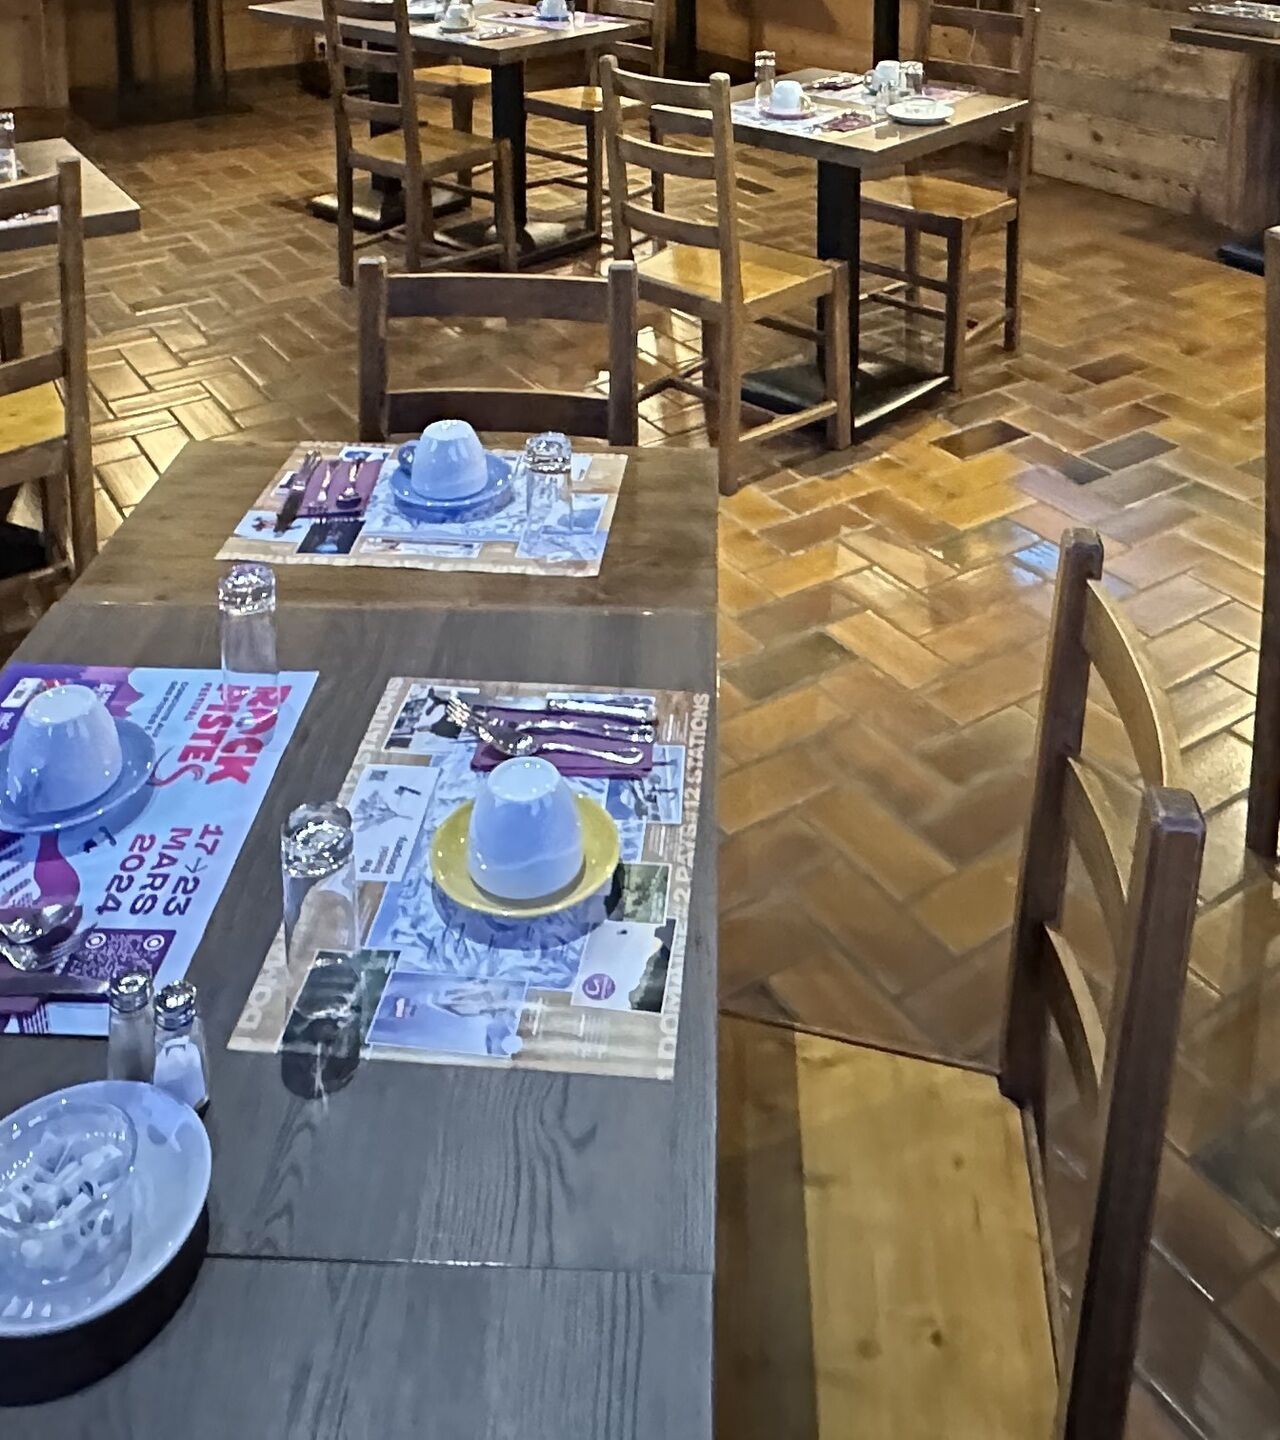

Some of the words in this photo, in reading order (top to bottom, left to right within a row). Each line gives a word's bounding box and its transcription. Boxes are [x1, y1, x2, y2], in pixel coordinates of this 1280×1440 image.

[146, 682, 251, 787] PISTES
[205, 684, 292, 785] ROCK
[684, 692, 711, 784] STATIONS
[94, 833, 156, 915] 2024
[129, 827, 194, 915] MARS
[194, 823, 224, 856] 17
[163, 875, 200, 916] 23
